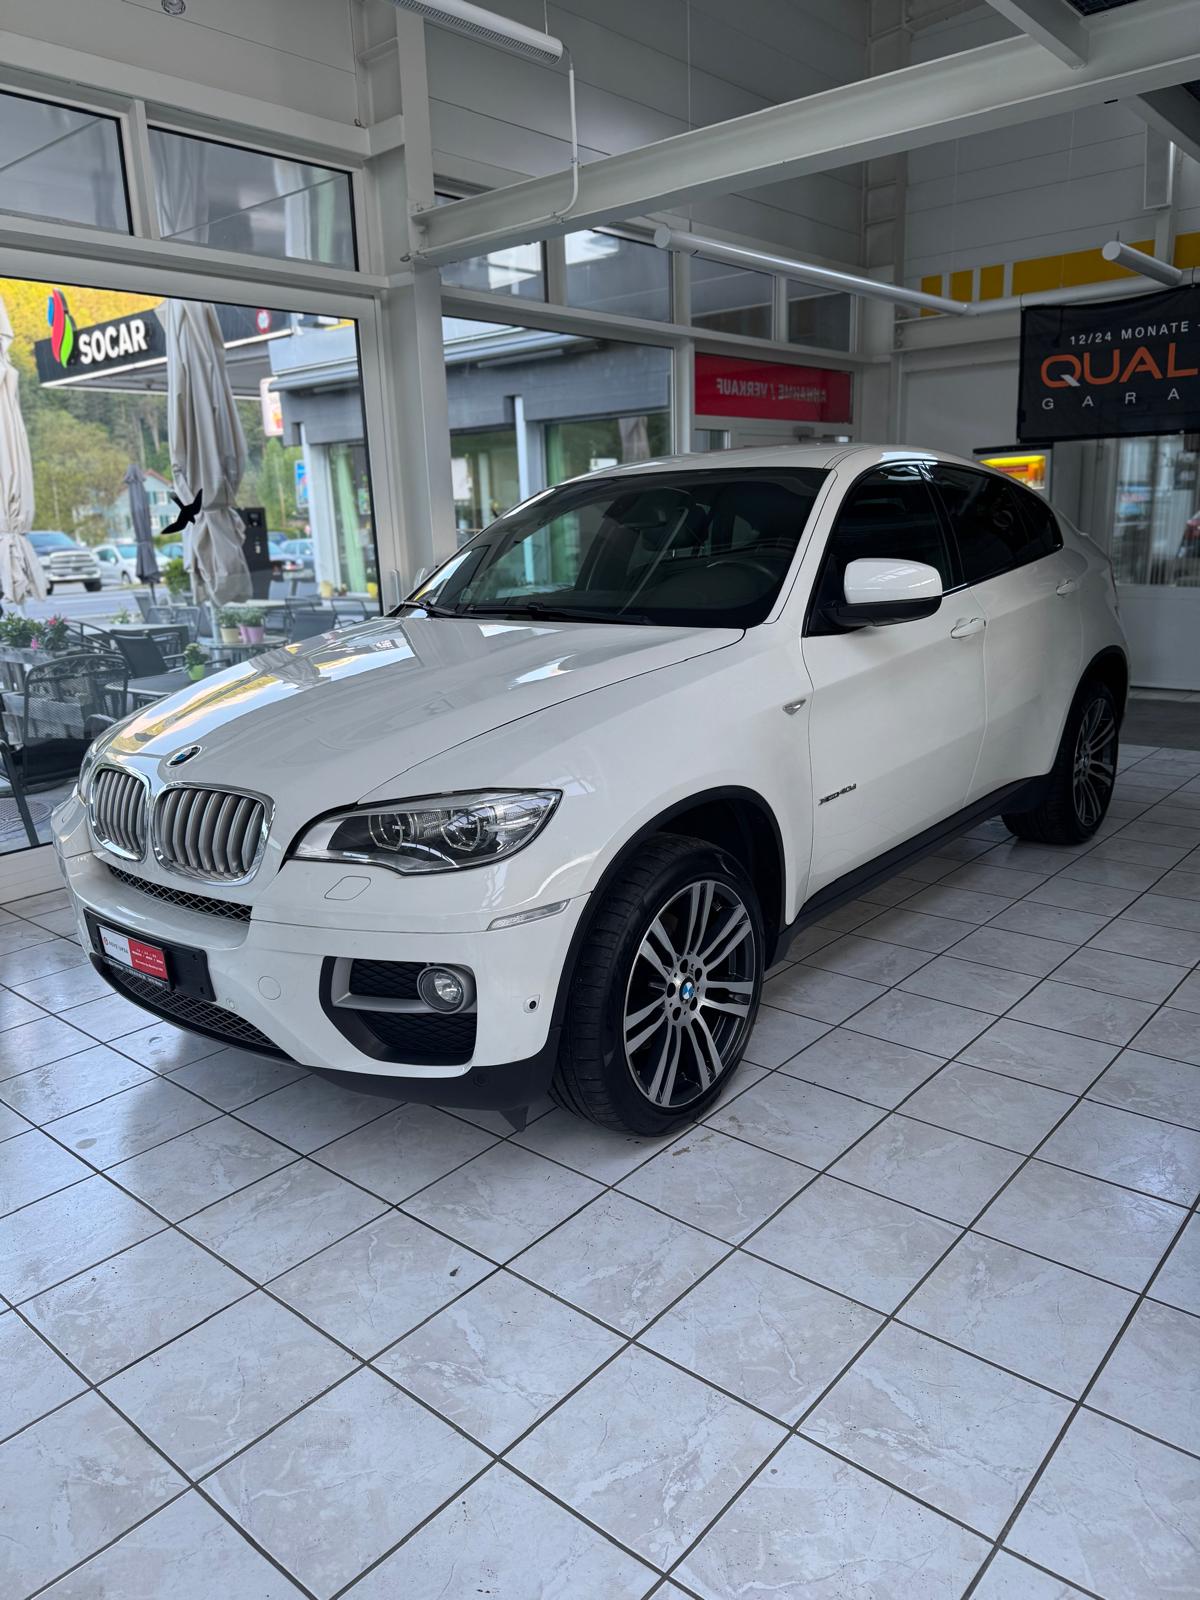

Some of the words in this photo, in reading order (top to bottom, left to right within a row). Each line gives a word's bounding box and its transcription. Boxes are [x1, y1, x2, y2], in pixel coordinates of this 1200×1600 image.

[79, 319, 148, 364] SOCAR
[1069, 331, 1112, 345] 12/24
[1121, 321, 1189, 340] MONATE
[1040, 342, 1199, 388] QUAL
